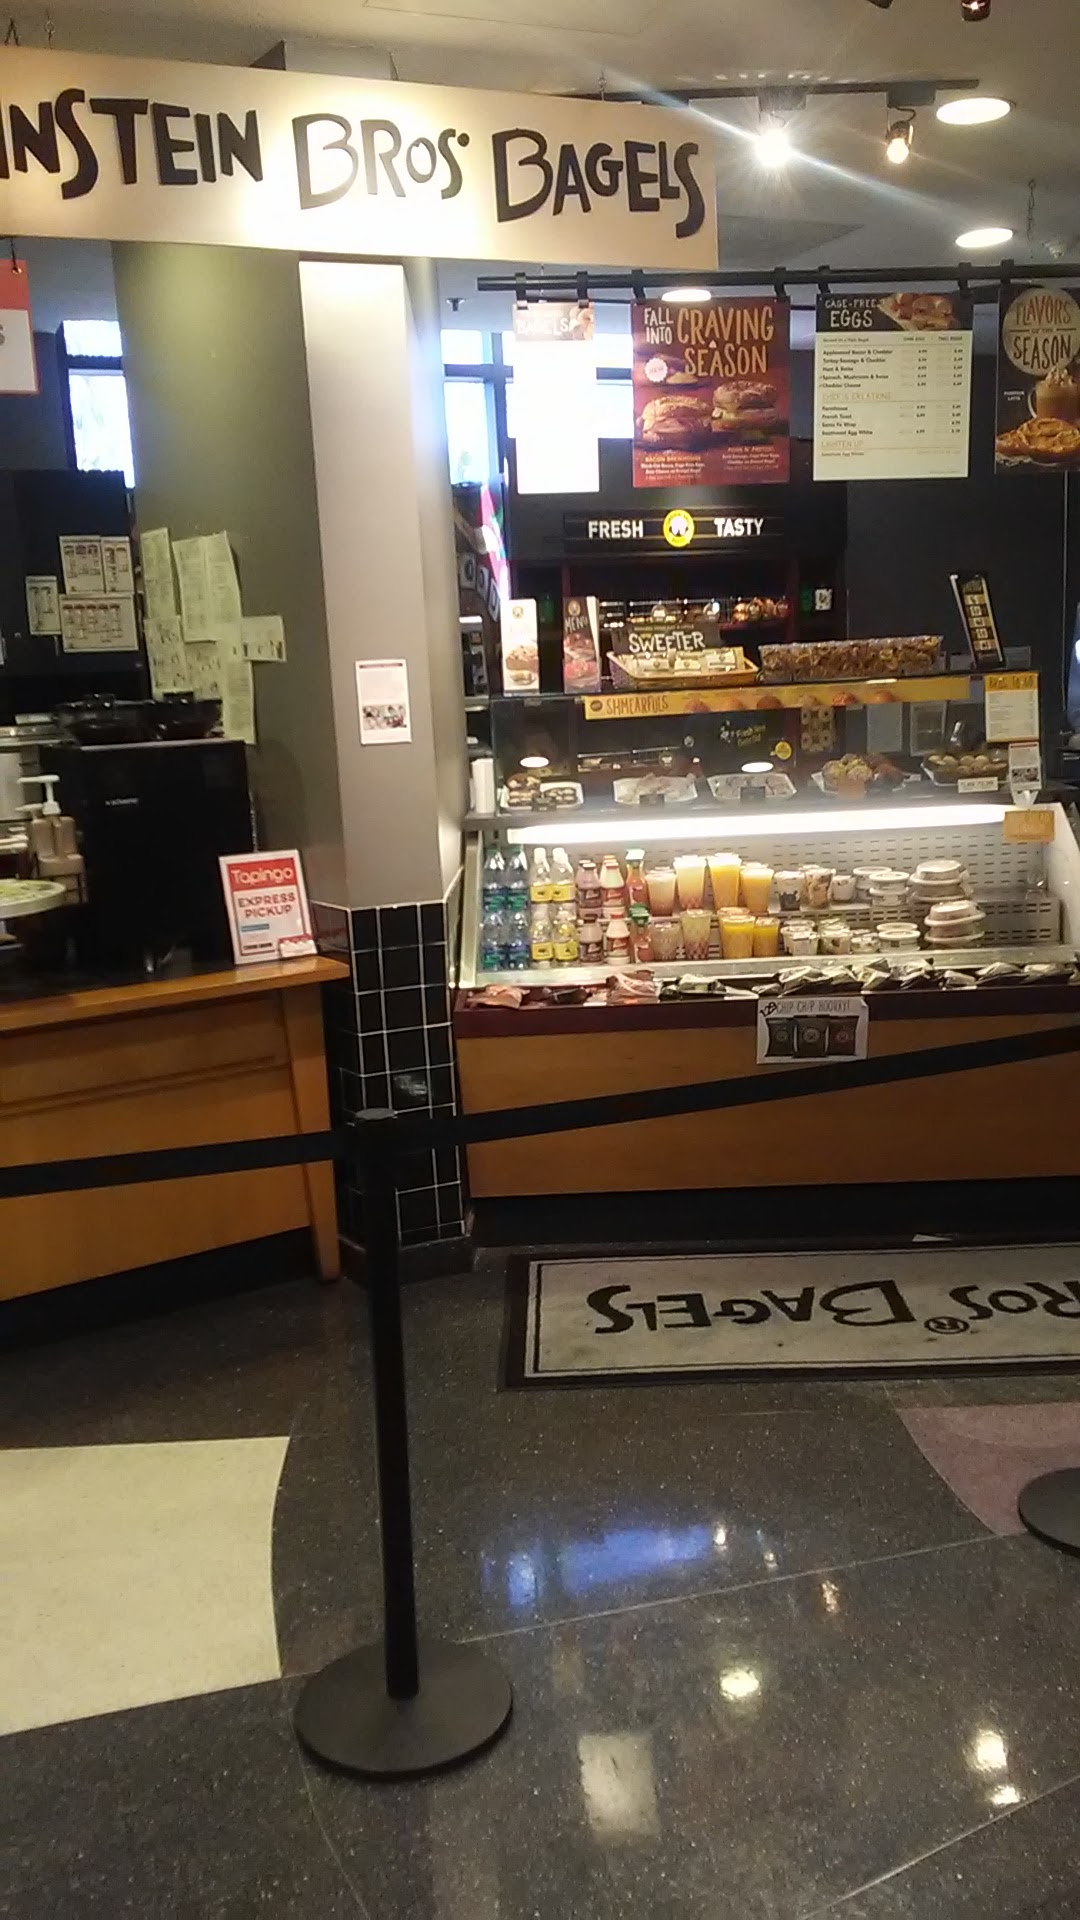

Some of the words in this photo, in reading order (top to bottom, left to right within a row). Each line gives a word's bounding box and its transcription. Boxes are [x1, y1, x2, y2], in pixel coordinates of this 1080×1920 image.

[492, 127, 706, 239] BAGELS
[824, 298, 877, 309] CAGE-FREE
[1014, 295, 1072, 326] FLAVORS
[644, 307, 674, 325] FALL
[677, 306, 774, 345] CRAVING
[830, 309, 873, 329] EGGS
[645, 326, 673, 345] INTO
[684, 343, 767, 378] SEASON
[1013, 333, 1071, 370] SEASON
[588, 520, 644, 539] FRESH
[713, 517, 764, 537] TASTY
[564, 615, 589, 633] MENU
[628, 631, 706, 653] SWEETER
[606, 695, 669, 715] SHMEARFULS
[231, 866, 294, 886] Tapingo
[238, 892, 296, 908] EXPRESS
[245, 904, 292, 918] PICKUP
[588, 1279, 917, 1334] BAGELS
